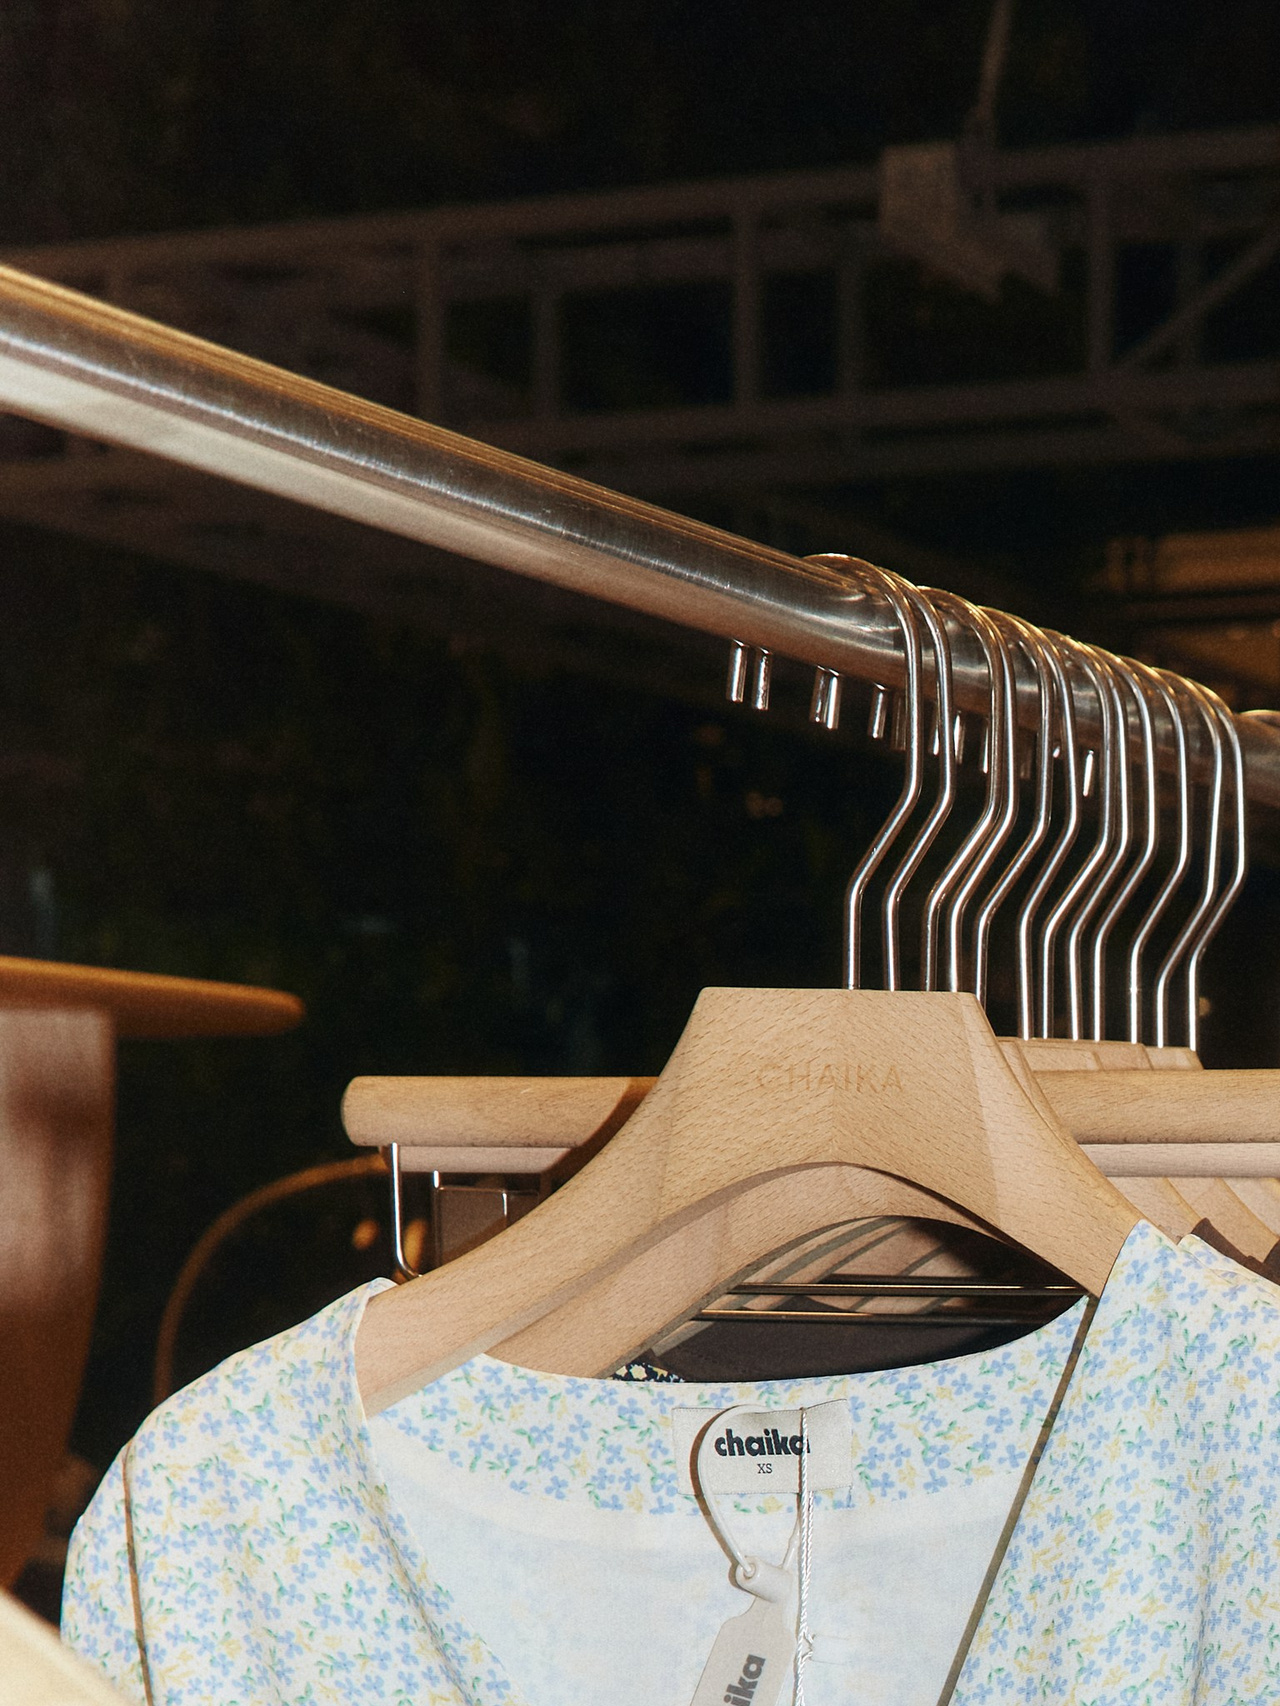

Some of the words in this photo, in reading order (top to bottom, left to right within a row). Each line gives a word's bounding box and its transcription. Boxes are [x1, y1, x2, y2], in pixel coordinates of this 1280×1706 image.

[755, 1060, 904, 1094] CHAIKA
[714, 1428, 811, 1457] chaika
[757, 1463, 773, 1474] XS
